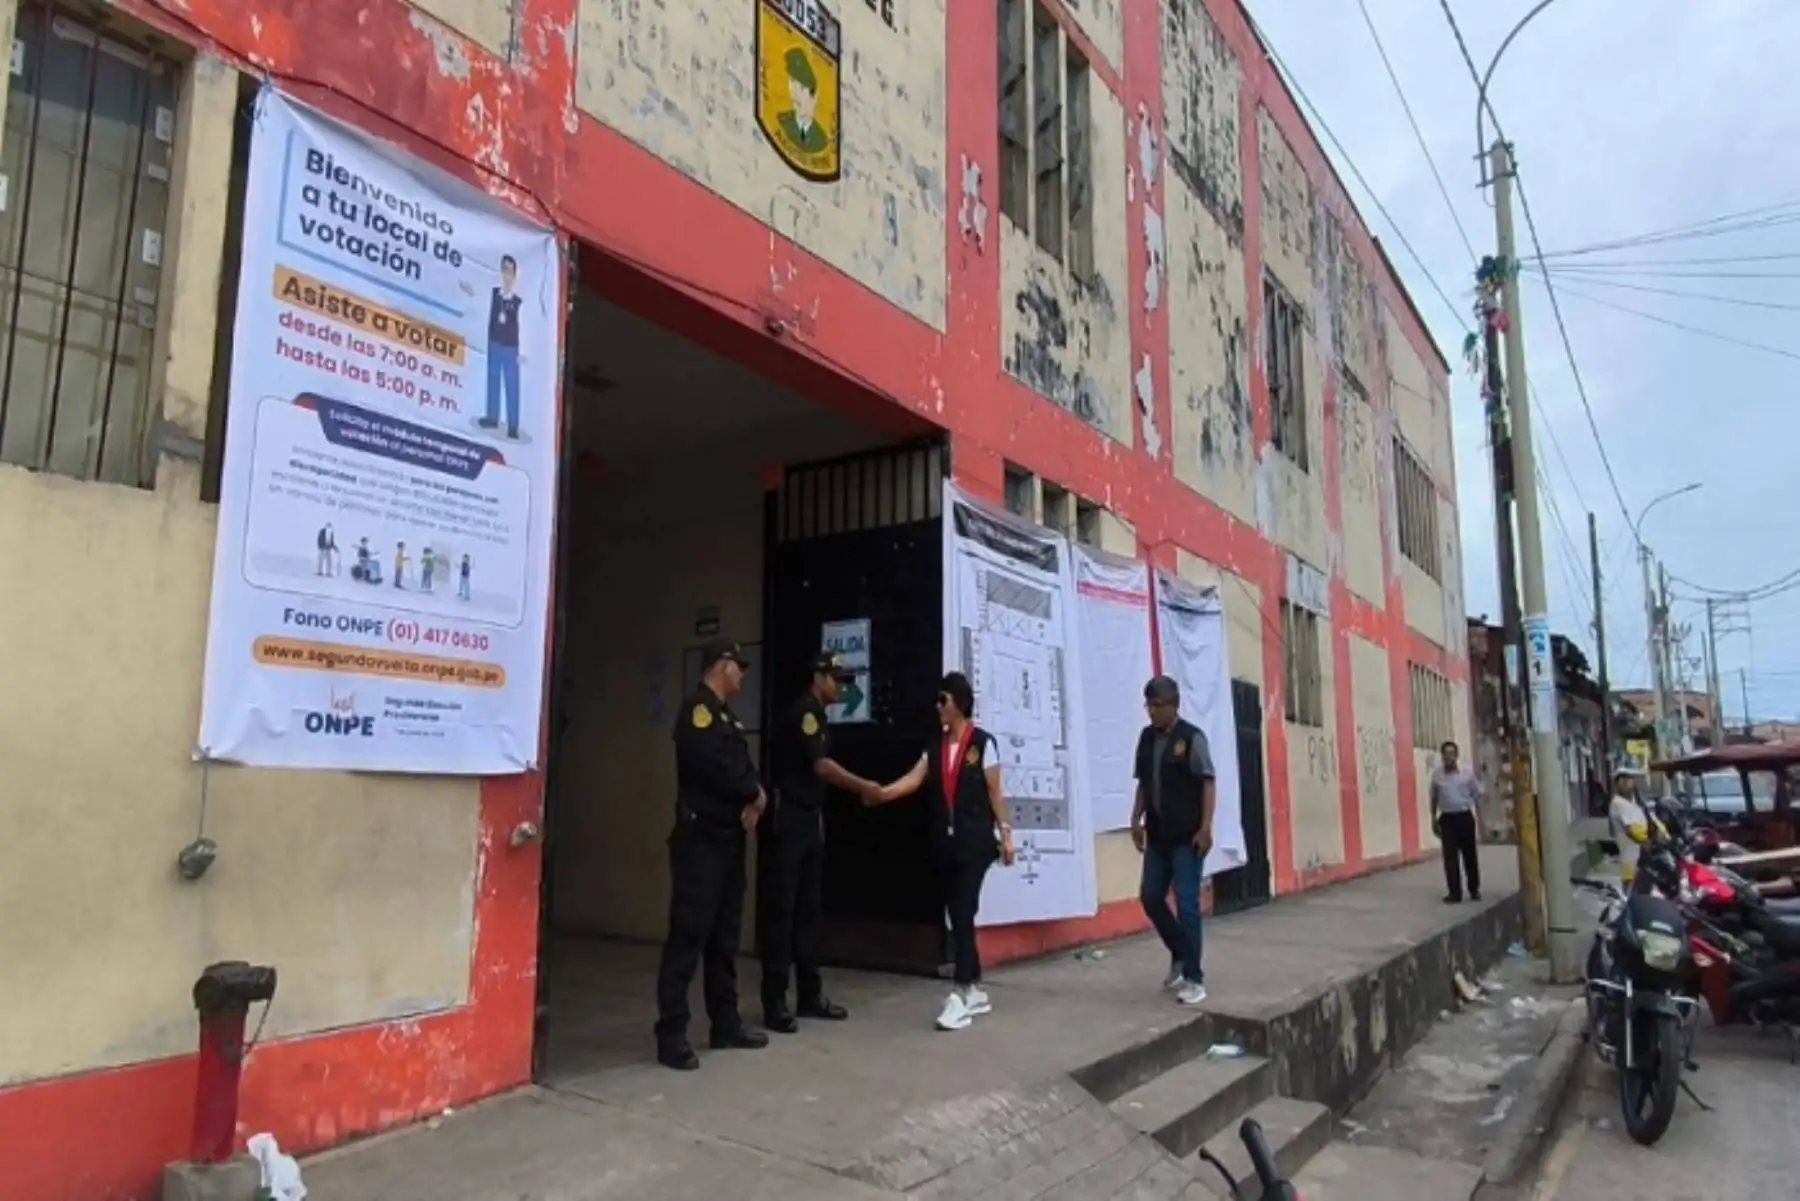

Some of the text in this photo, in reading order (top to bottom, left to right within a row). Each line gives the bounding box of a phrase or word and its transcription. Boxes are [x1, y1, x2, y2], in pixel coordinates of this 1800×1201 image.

[306, 148, 454, 236] Bienvenido
[299, 213, 422, 280] votación
[302, 185, 464, 268] a tu local de
[279, 309, 342, 347] desde
[348, 331, 376, 360] las
[380, 345, 418, 373] 7:00
[282, 276, 458, 359] Asiste a votar
[276, 337, 337, 374] hasta
[341, 357, 371, 385] las
[376, 370, 415, 398] 5:00
[284, 607, 332, 630] Fono
[336, 615, 384, 637] ONPE
[386, 618, 420, 645] (01)
[305, 711, 375, 737] ONPE
